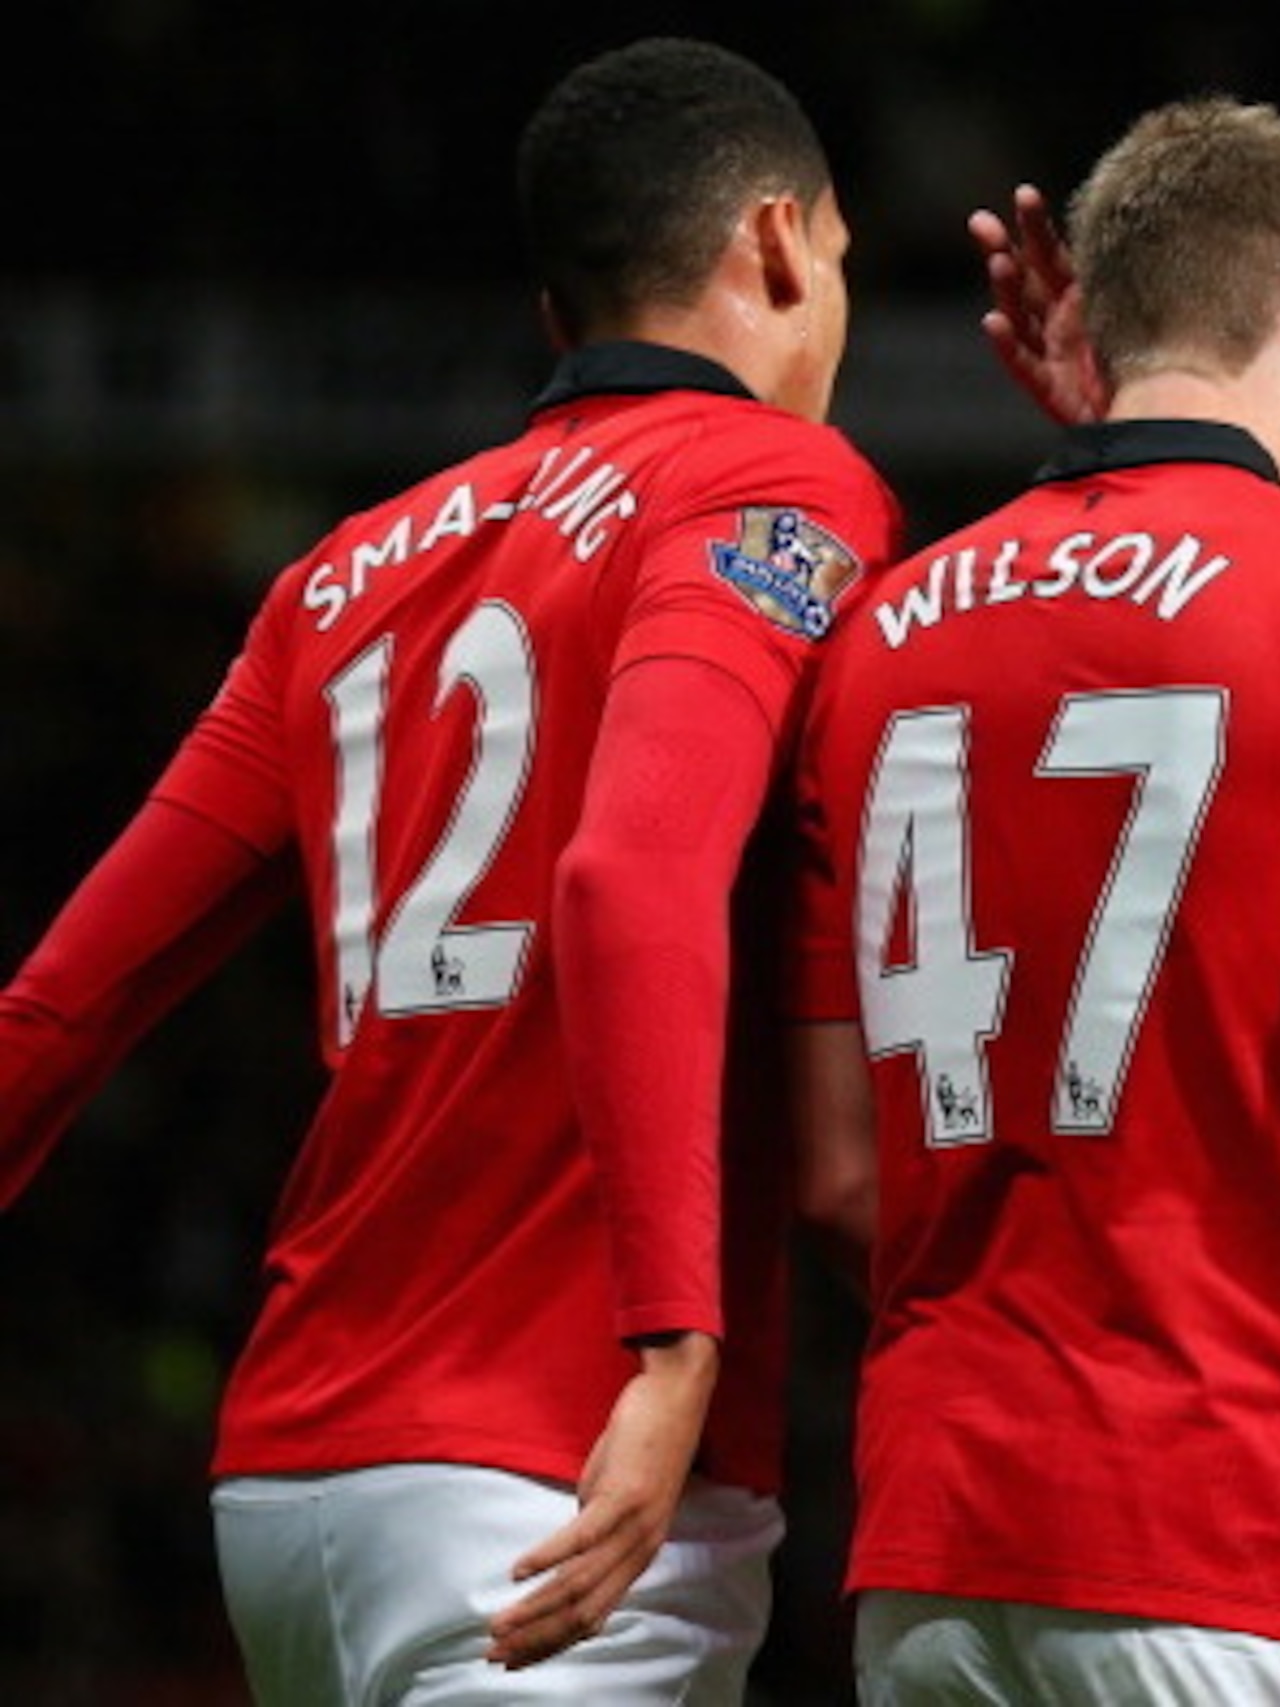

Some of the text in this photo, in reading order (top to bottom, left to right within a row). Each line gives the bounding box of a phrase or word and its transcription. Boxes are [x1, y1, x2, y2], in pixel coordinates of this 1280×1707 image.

[875, 531, 1230, 649] WILSON
[323, 597, 537, 1048] 12
[854, 685, 1231, 1149] 47
